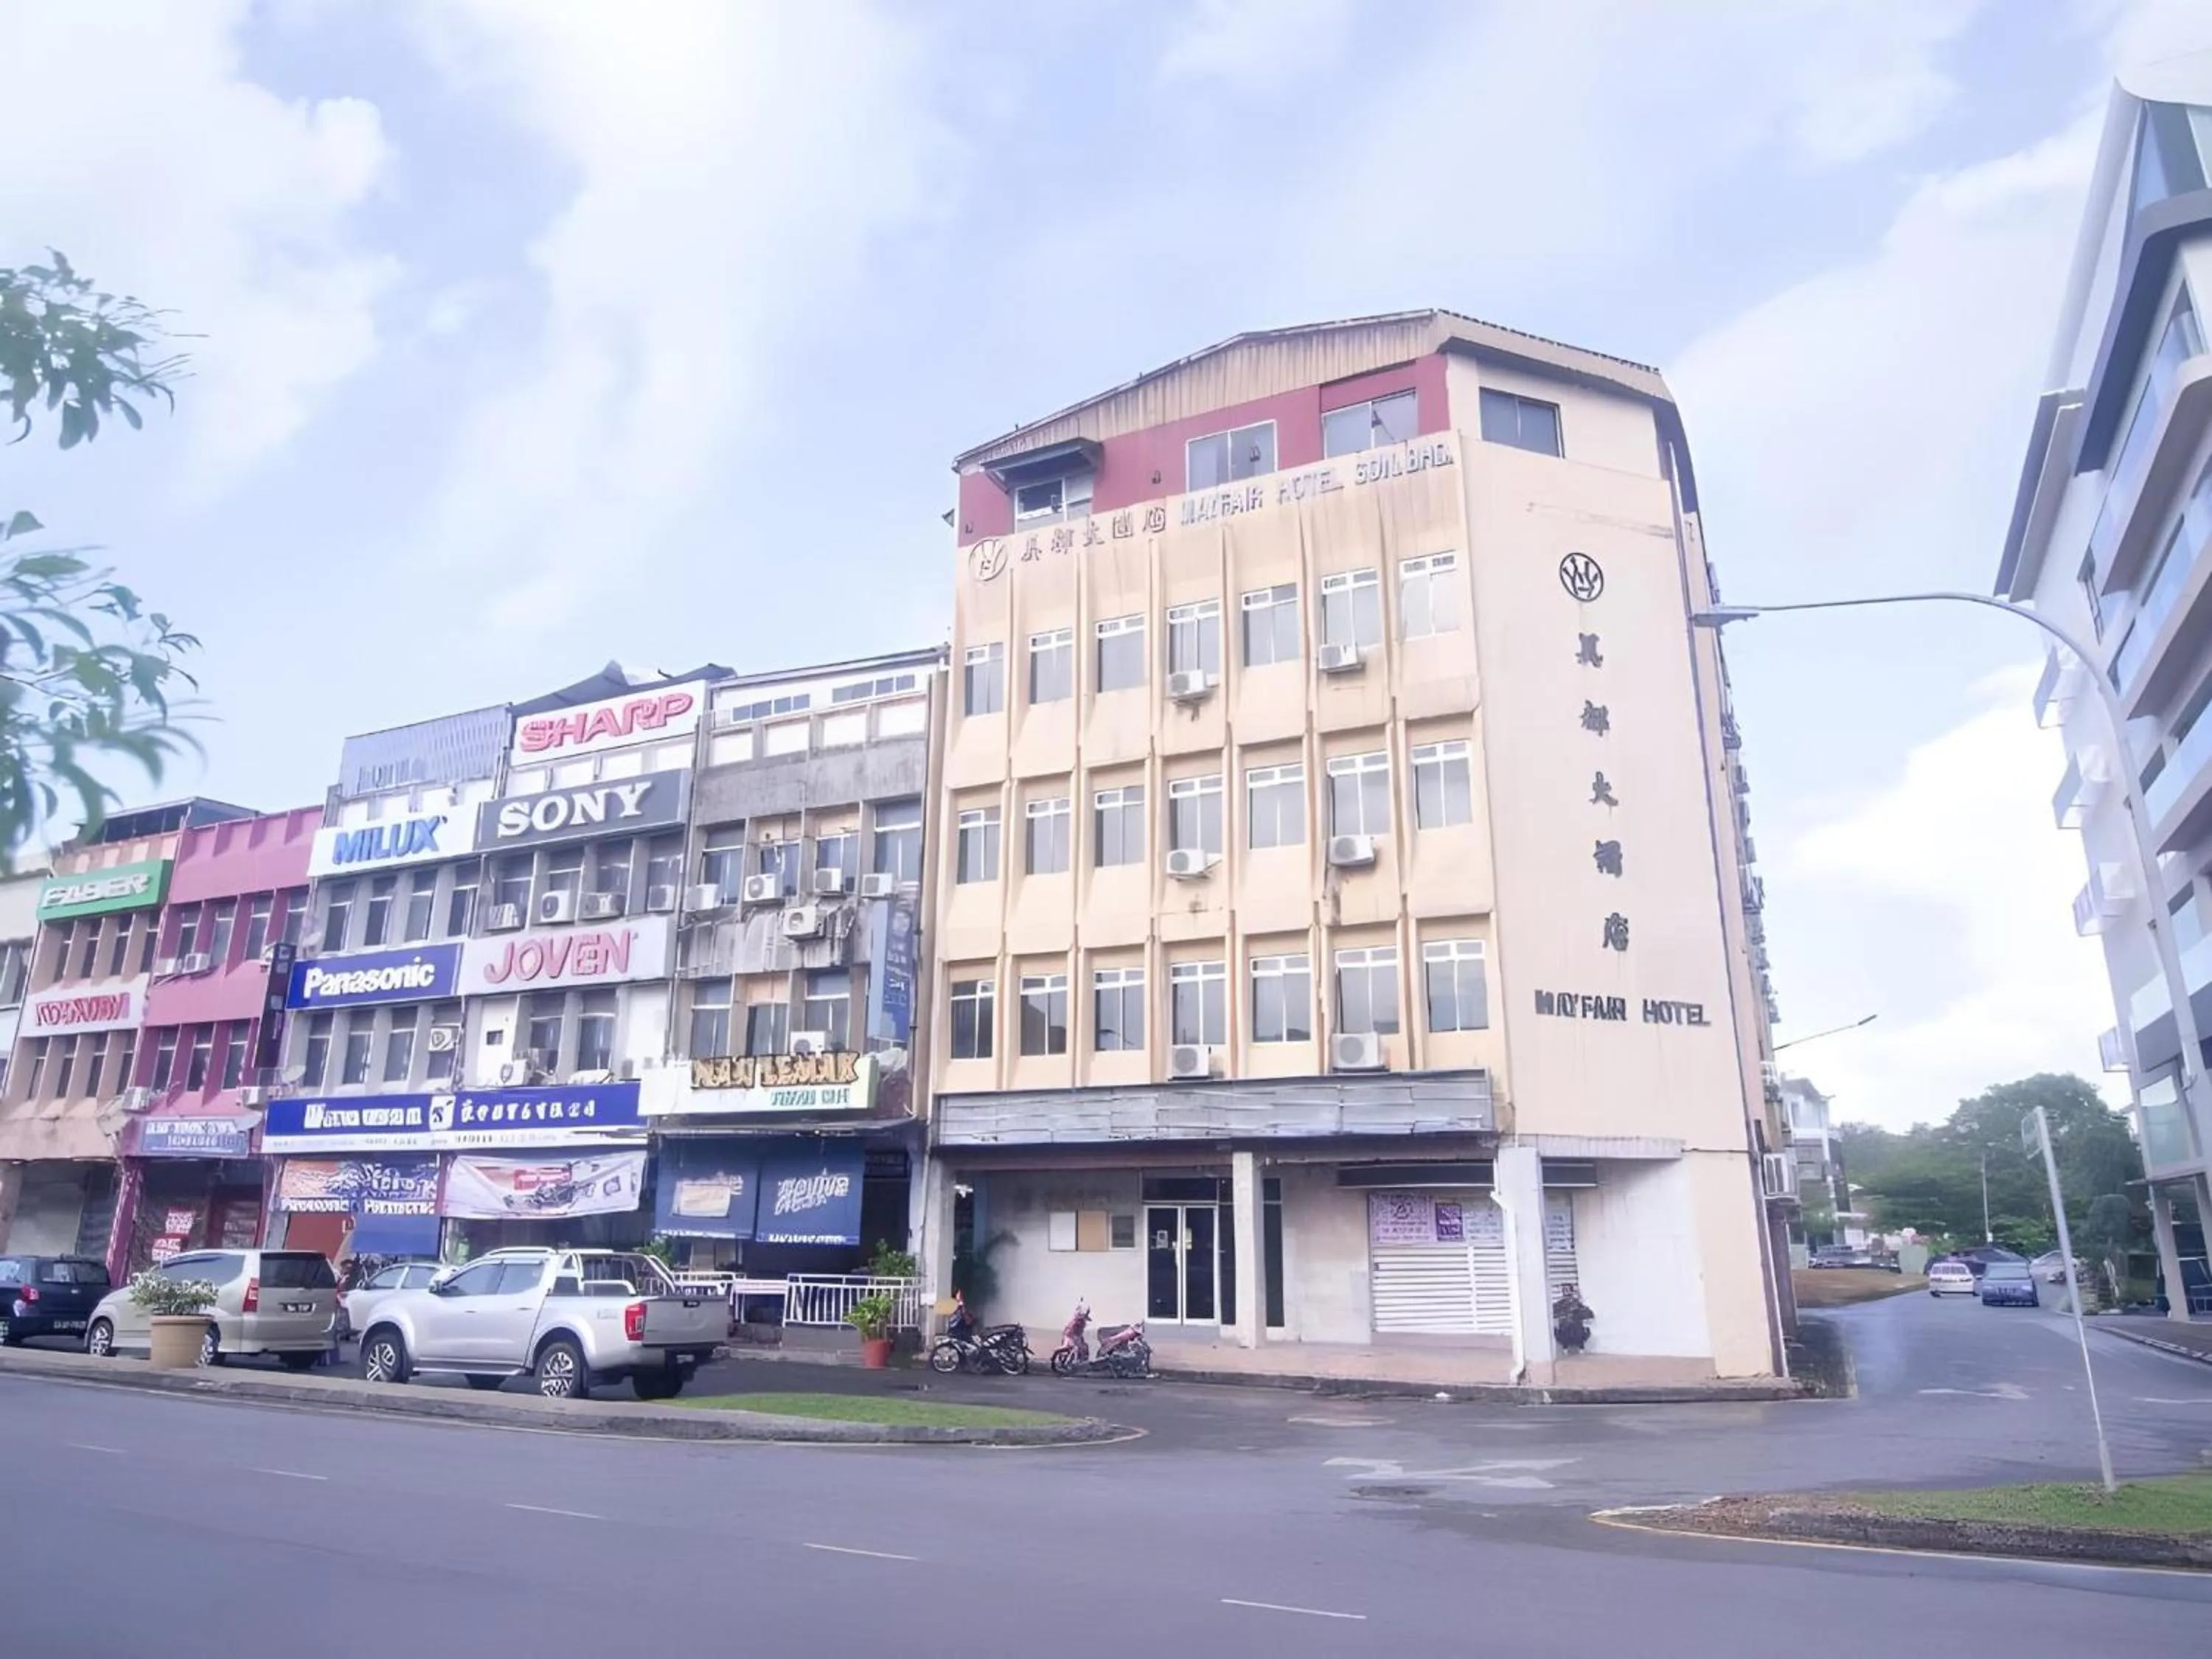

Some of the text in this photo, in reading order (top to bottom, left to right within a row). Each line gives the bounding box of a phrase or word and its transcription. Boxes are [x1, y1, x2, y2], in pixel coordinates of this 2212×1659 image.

[520, 692, 694, 752] SHARP
[497, 780, 653, 838] SONY
[332, 815, 441, 866] MILUX
[304, 956, 435, 997] Panasonic
[484, 928, 631, 984] JOVEN
[1534, 990, 1711, 1027] MAYFAIR HOTEL
